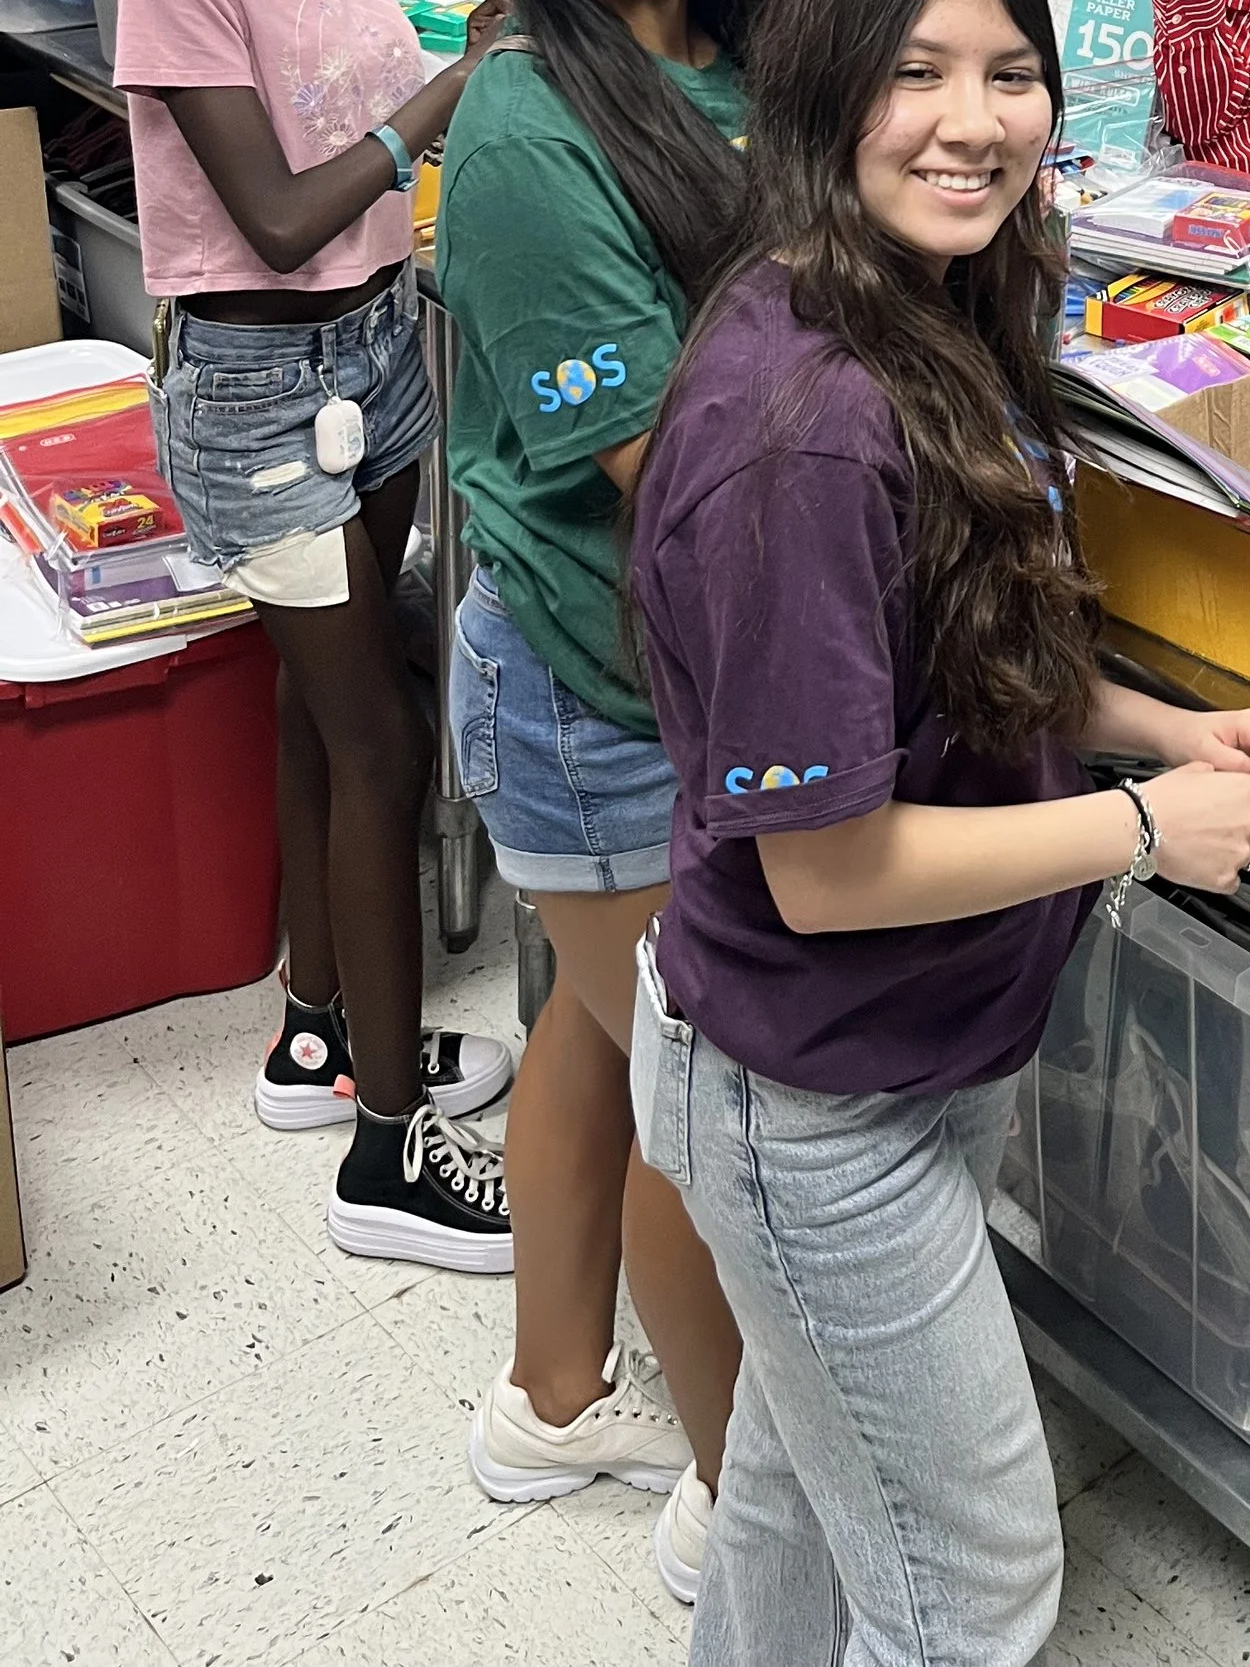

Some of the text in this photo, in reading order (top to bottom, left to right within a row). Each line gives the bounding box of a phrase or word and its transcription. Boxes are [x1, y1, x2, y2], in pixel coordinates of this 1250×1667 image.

[1087, 3, 1131, 22] PAPER
[1076, 19, 1154, 70] 150
[531, 343, 627, 413] SOS
[137, 514, 154, 531] 24
